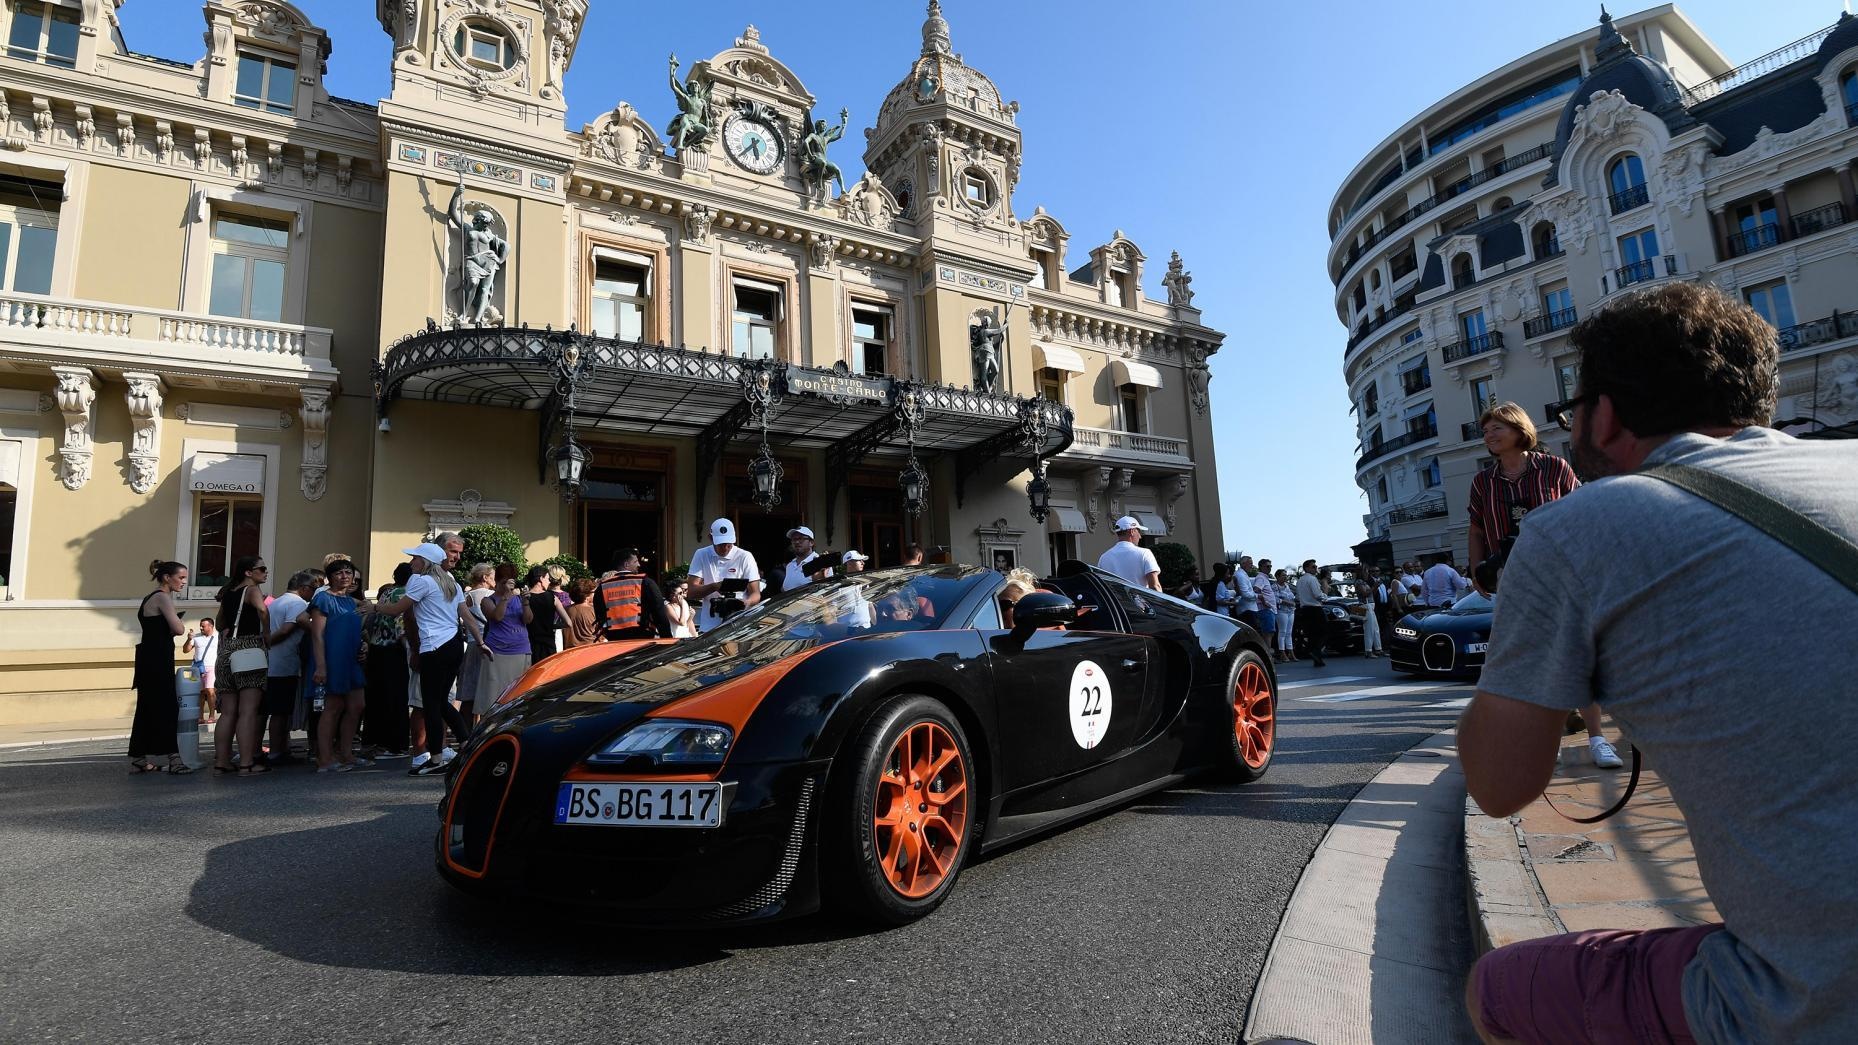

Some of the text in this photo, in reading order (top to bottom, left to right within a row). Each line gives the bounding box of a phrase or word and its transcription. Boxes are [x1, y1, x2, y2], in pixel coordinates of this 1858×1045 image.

[820, 375, 863, 388] CASINO
[206, 482, 243, 492] OMEGA
[1081, 685, 1102, 717] 22
[569, 787, 717, 821] BS BG 117
